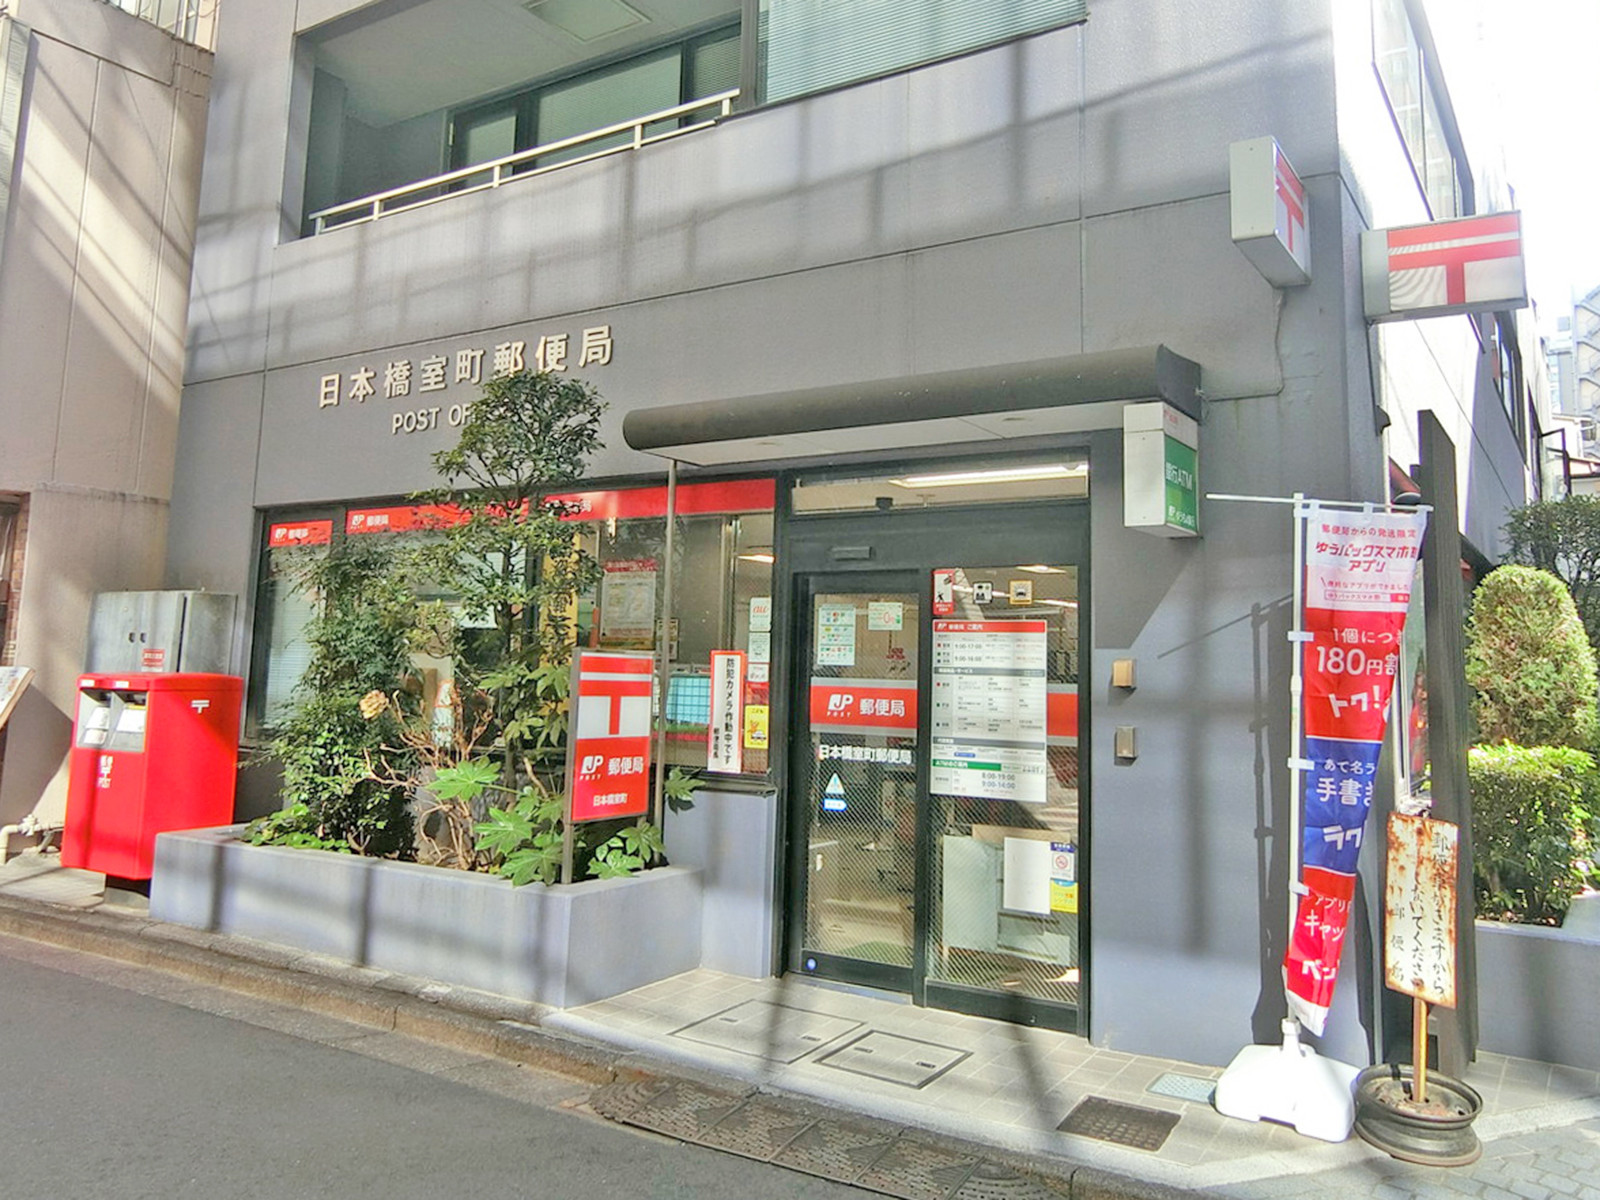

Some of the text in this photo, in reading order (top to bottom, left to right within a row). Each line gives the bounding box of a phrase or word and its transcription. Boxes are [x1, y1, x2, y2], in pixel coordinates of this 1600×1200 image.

[319, 325, 613, 409] 日本橋室町郵便局
[391, 407, 440, 435] POST
[1348, 559, 1386, 573] アプリ
[859, 698, 905, 717] 郵便局
[608, 756, 644, 776] 郵便局
[593, 792, 628, 807] 日本橋室町
